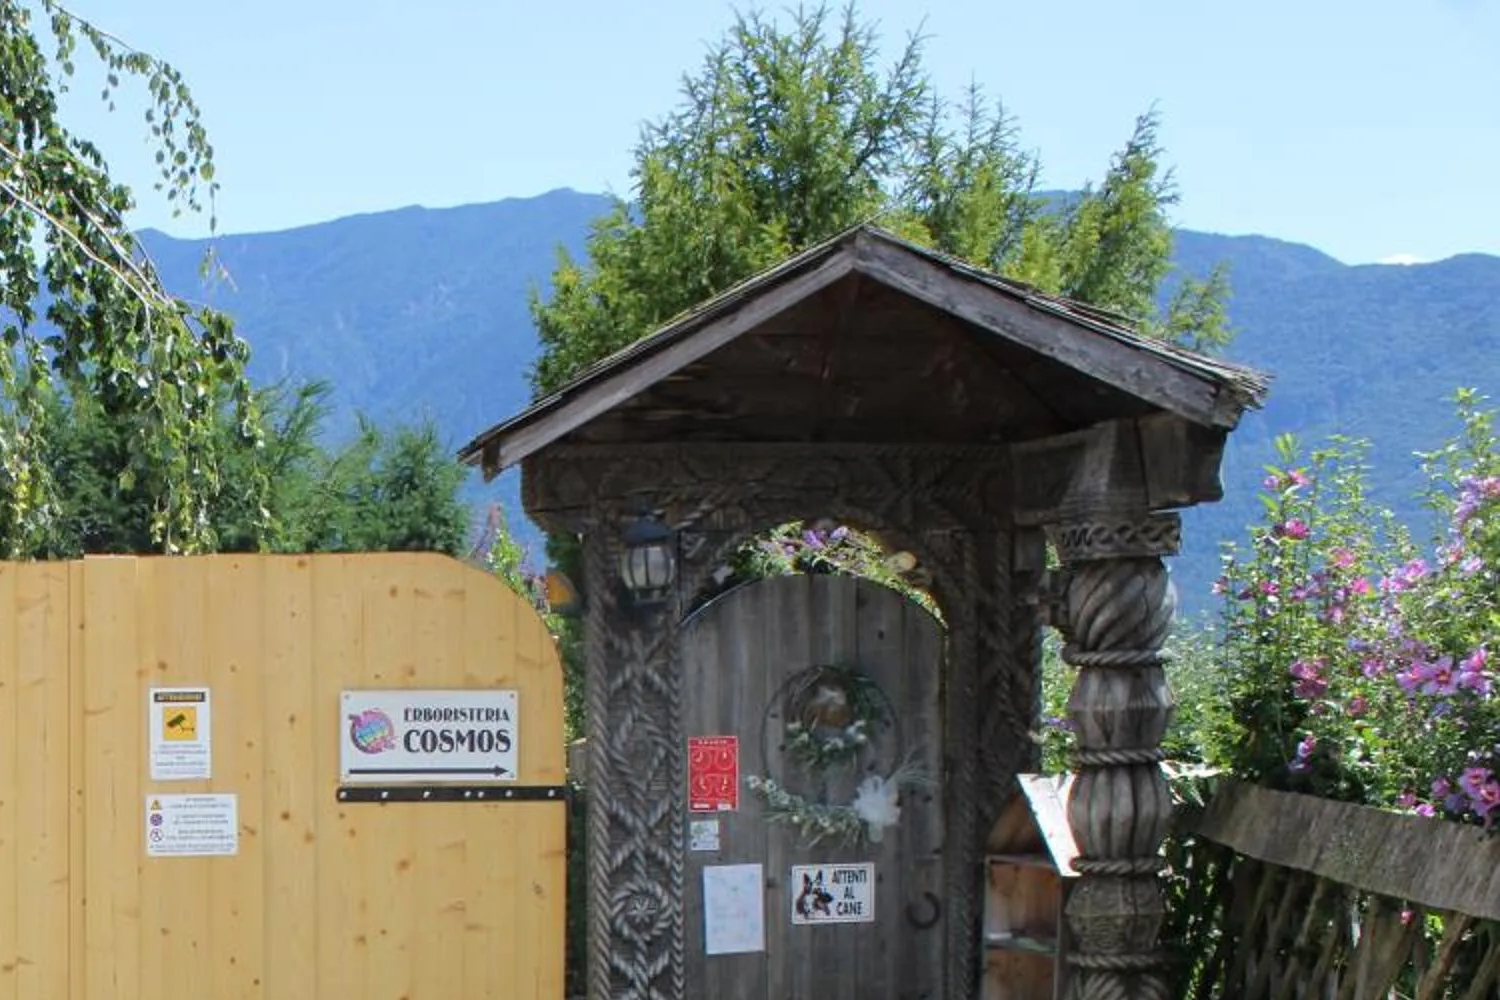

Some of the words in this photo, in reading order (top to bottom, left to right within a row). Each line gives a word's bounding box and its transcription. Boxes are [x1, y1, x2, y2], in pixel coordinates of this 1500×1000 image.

[403, 707, 510, 722] ERBORISTERIA
[403, 729, 511, 753] COSMOS
[831, 869, 867, 884] ATTENTI
[843, 886, 855, 899] AL
[836, 901, 863, 916] CANE
